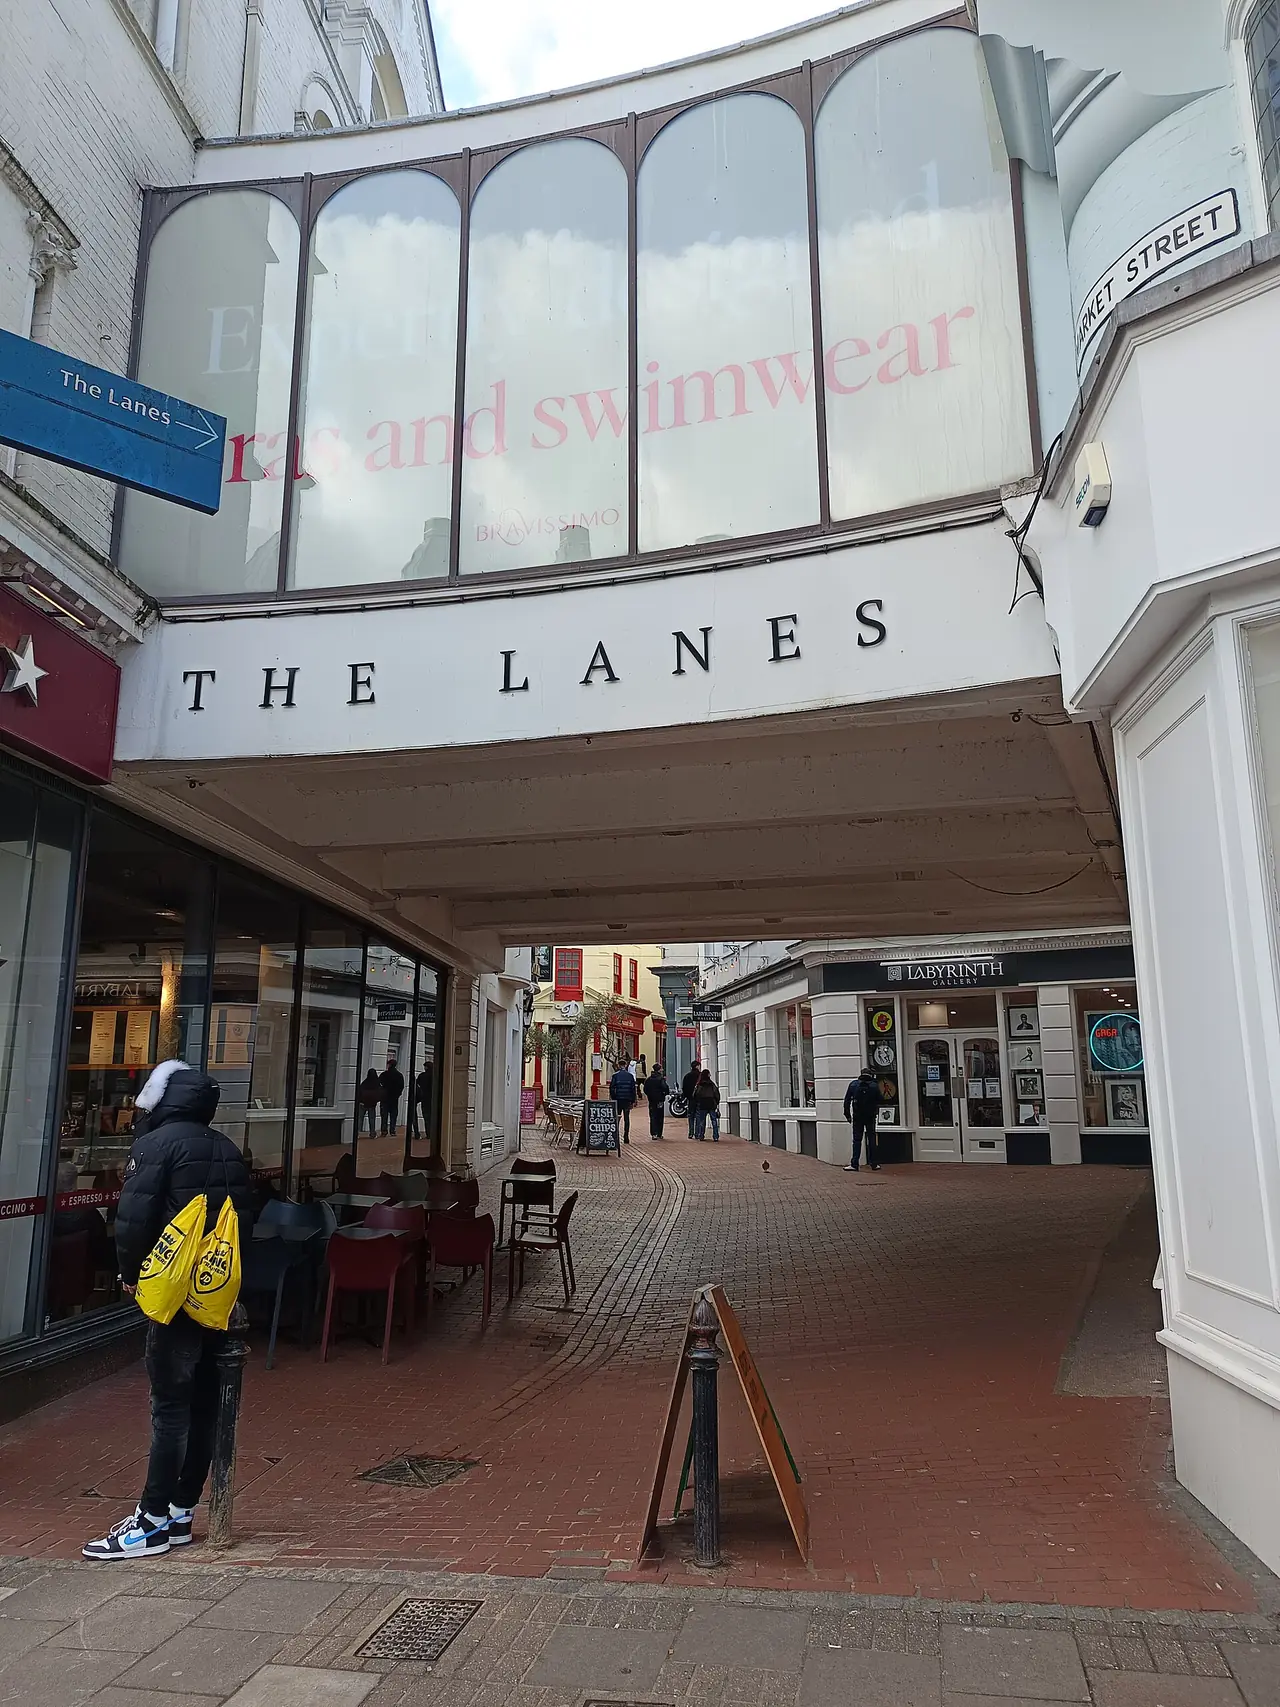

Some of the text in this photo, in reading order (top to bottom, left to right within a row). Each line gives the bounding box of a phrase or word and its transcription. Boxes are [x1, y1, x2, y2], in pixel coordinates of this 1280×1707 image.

[1126, 204, 1223, 282] STREET
[60, 369, 171, 426] The Lanes
[225, 306, 976, 484] ras and swimwear
[476, 508, 620, 546] BRAVISSIMO
[182, 598, 887, 711] THE LANES
[906, 961, 1004, 980] LABYRINTH
[932, 978, 978, 986] GALLERY
[589, 1107, 614, 1118] FISH
[589, 1123, 616, 1132] CHIPS
[0, 1190, 120, 1216] CCINO ESPRESSO SO
[154, 1241, 173, 1260] NG
[200, 1274, 211, 1284] JD
